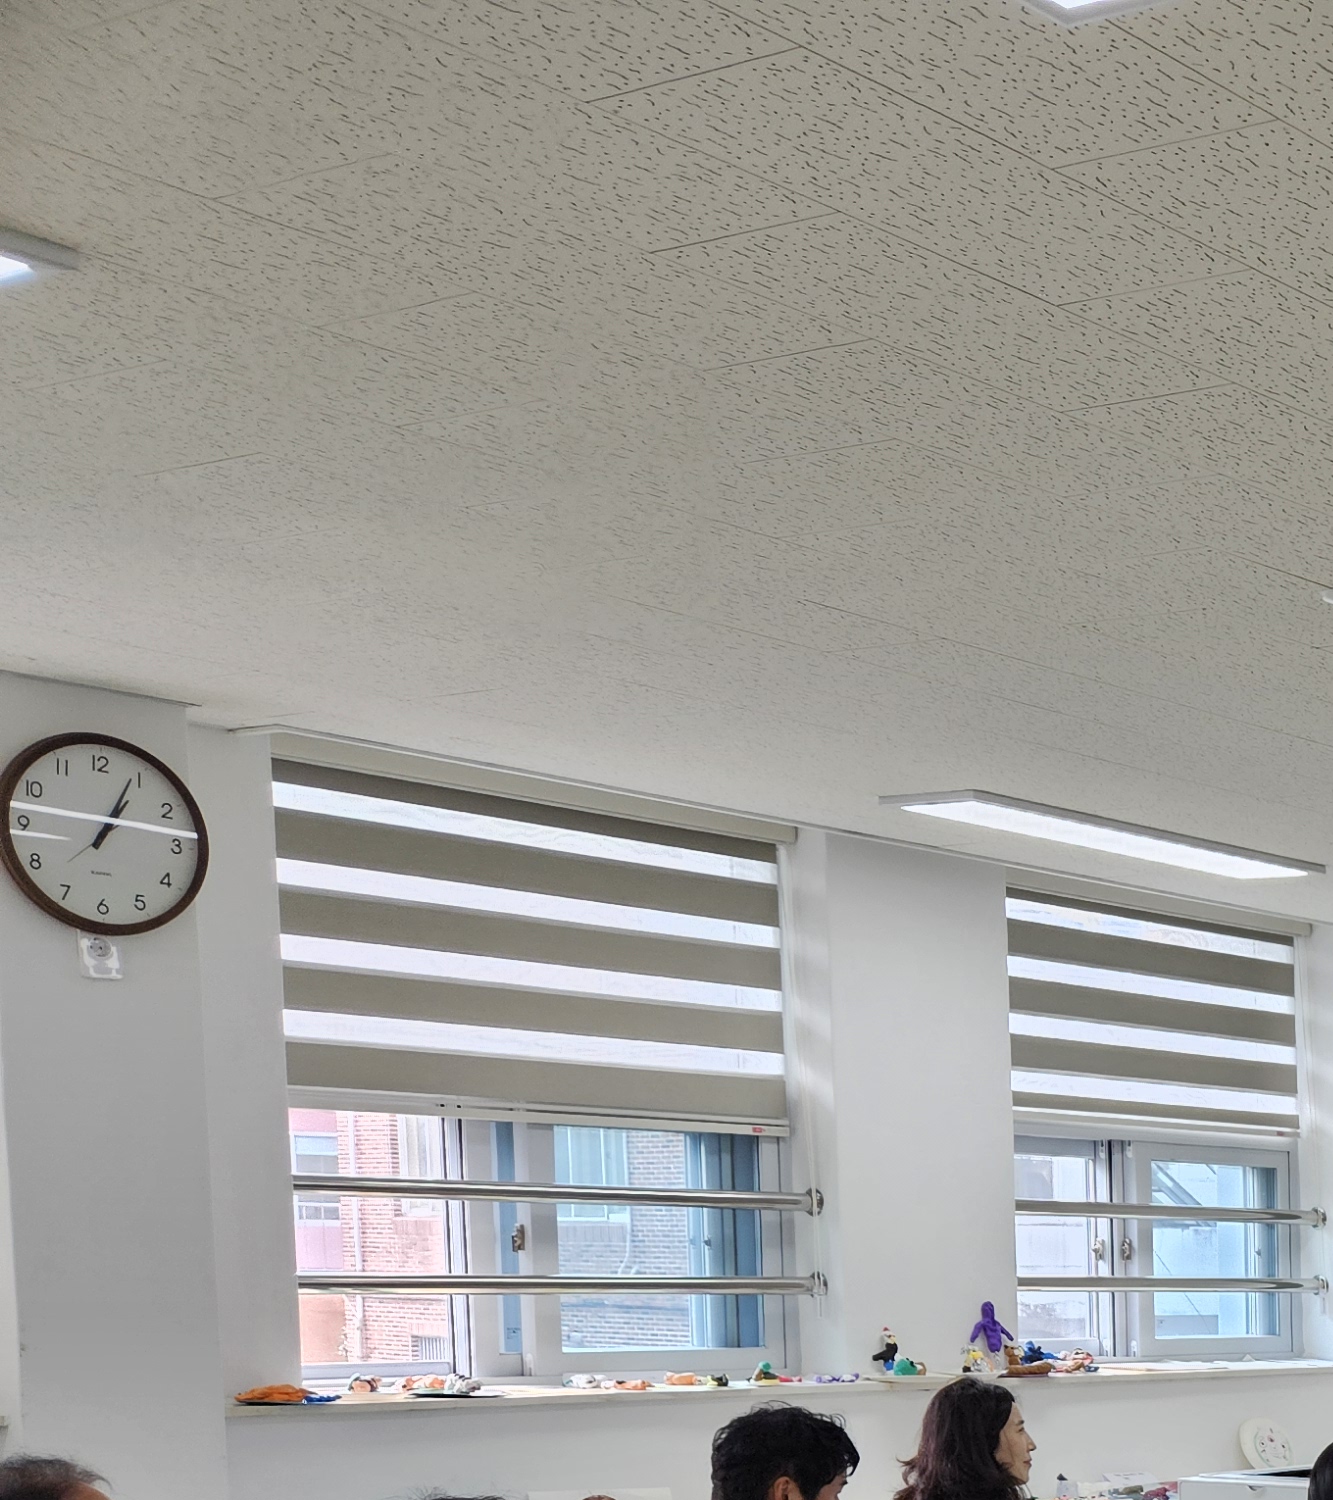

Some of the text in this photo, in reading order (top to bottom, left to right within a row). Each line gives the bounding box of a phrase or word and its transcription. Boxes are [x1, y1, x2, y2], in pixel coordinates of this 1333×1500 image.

[56, 757, 69, 777] 11
[91, 754, 109, 774] 12
[25, 779, 43, 798] 10
[161, 802, 173, 819] 2
[17, 815, 30, 831] 9
[171, 838, 182, 854] 3
[29, 852, 42, 869] 8
[160, 872, 172, 888] 4
[59, 884, 71, 900] 7
[97, 898, 109, 915] 6
[133, 894, 146, 911] 5
